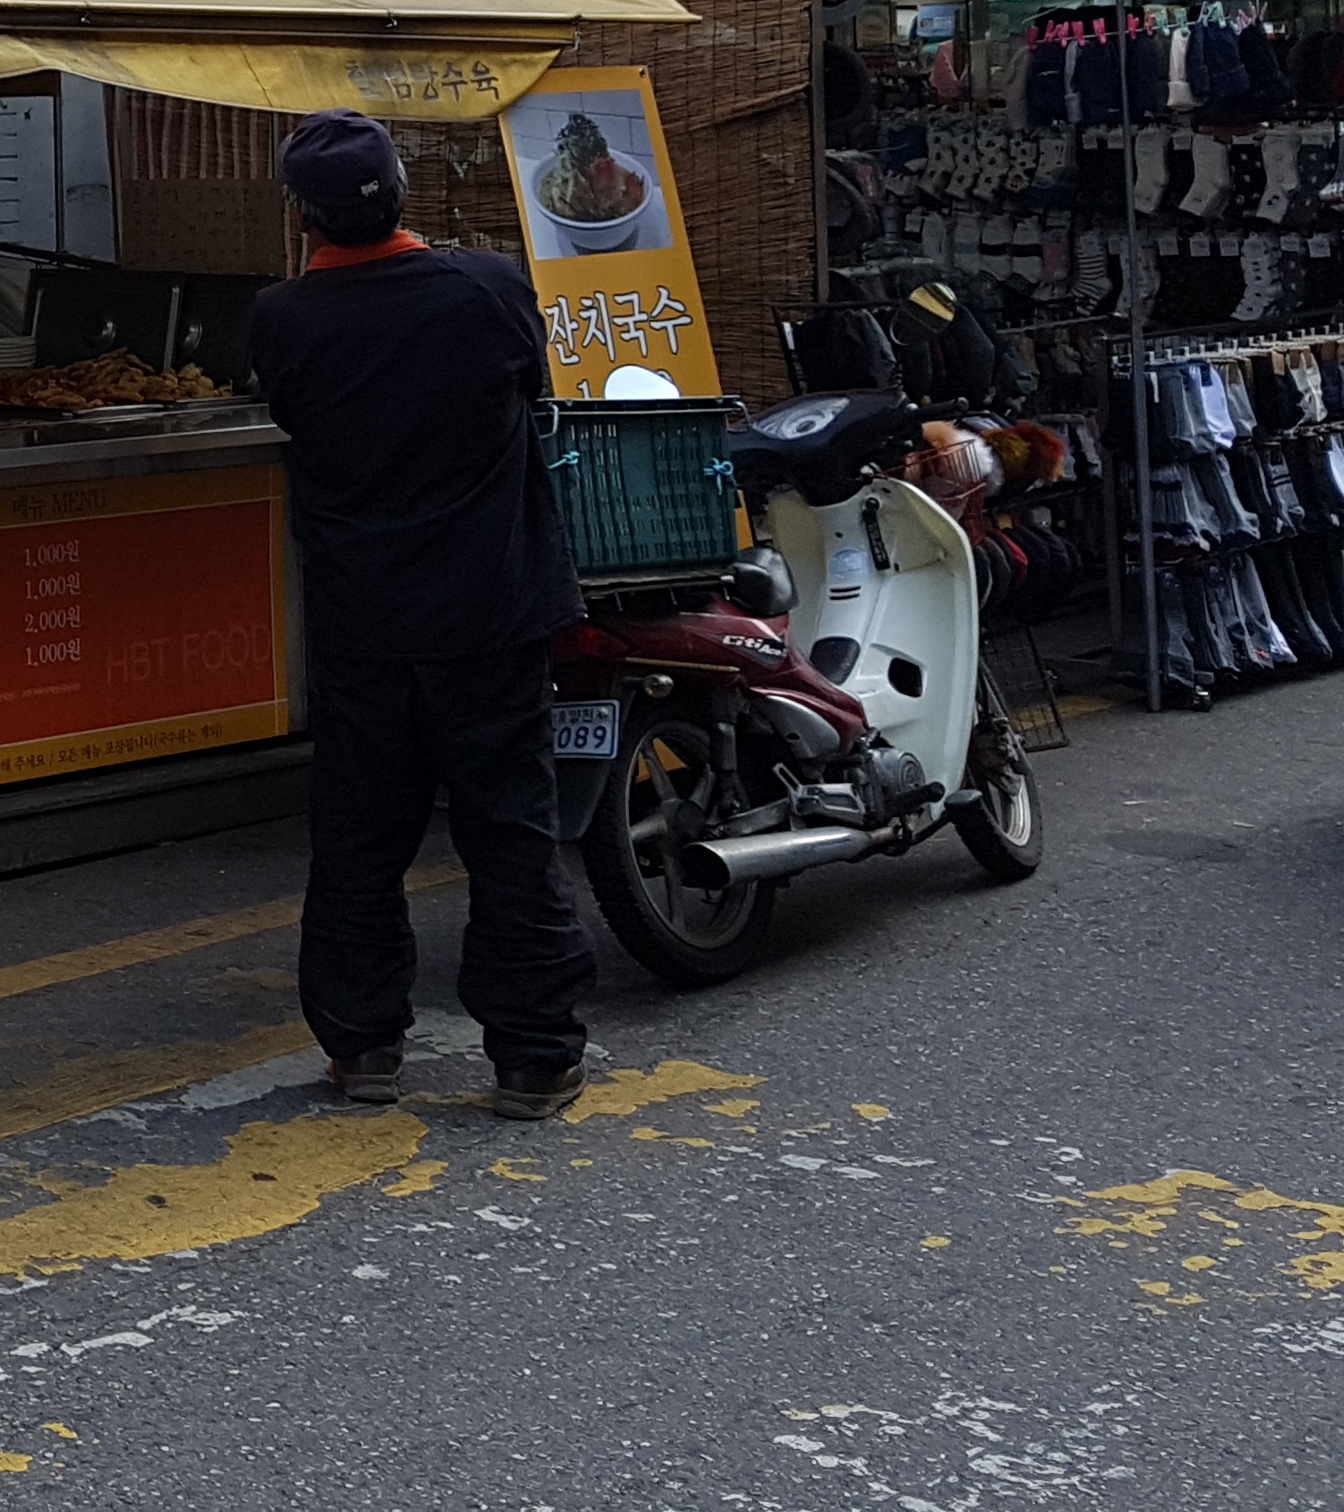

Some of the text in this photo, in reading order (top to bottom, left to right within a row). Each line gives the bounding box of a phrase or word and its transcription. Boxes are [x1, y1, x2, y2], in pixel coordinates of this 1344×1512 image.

[545, 286, 692, 365] 잔치국수
[52, 489, 106, 514] MENU
[106, 624, 271, 683] HBT FOOD
[553, 726, 607, 749] 089
